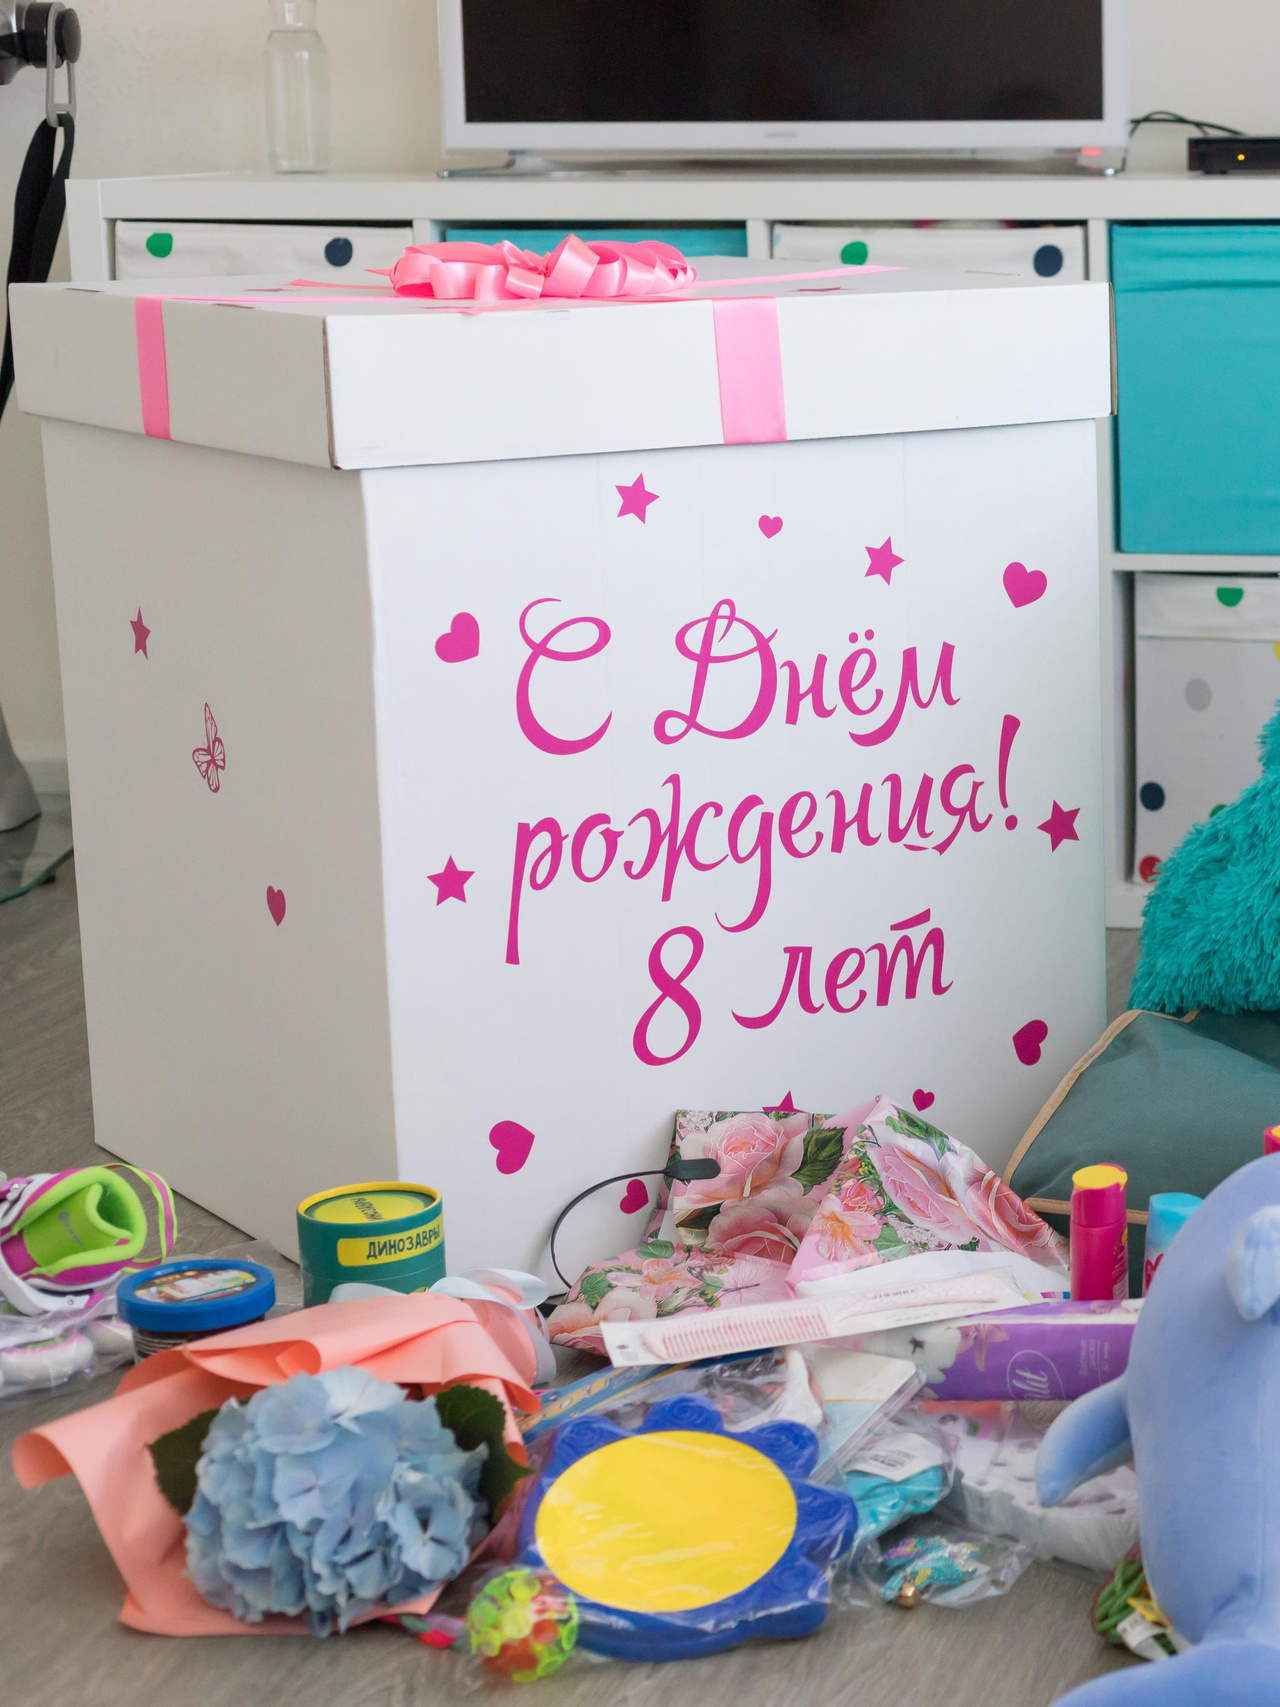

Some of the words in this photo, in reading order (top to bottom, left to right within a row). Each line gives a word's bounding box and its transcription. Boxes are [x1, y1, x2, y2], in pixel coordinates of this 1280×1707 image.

[516, 597, 613, 756] С
[653, 598, 961, 747] Днём
[505, 714, 1021, 966] рождения!
[632, 925, 705, 1067] 8
[731, 908, 954, 1030] лет
[366, 1224, 441, 1260] ДИНОЗАВРЫ
